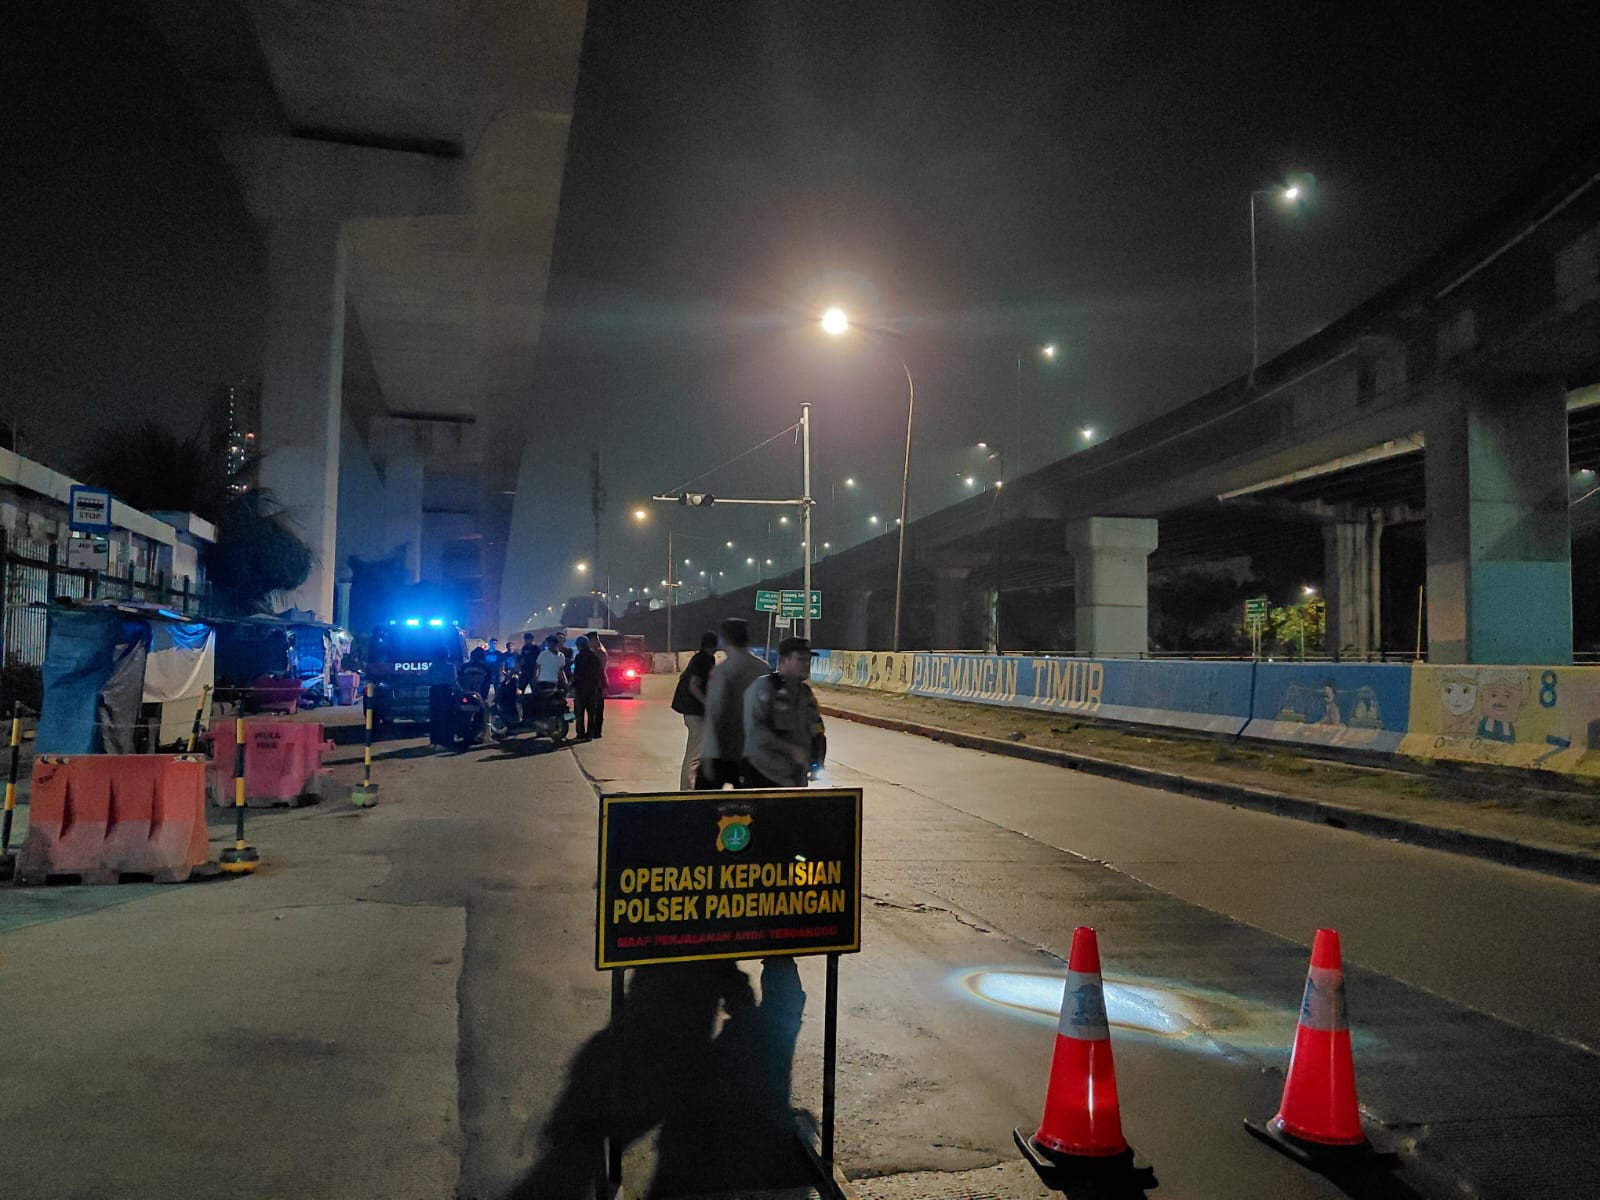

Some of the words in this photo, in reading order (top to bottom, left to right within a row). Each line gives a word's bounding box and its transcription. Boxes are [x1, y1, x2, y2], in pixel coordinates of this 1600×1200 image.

[910, 655, 1019, 701] PADEMANGAN
[1030, 659, 1104, 712] TIMUR
[1539, 670, 1558, 708] 8
[620, 865, 713, 894] OPERASI
[720, 860, 842, 889] KEPOLISIAN
[613, 895, 699, 924] POLSEK
[705, 889, 846, 919] PADEMANGAN
[617, 936, 650, 949] MAAF
